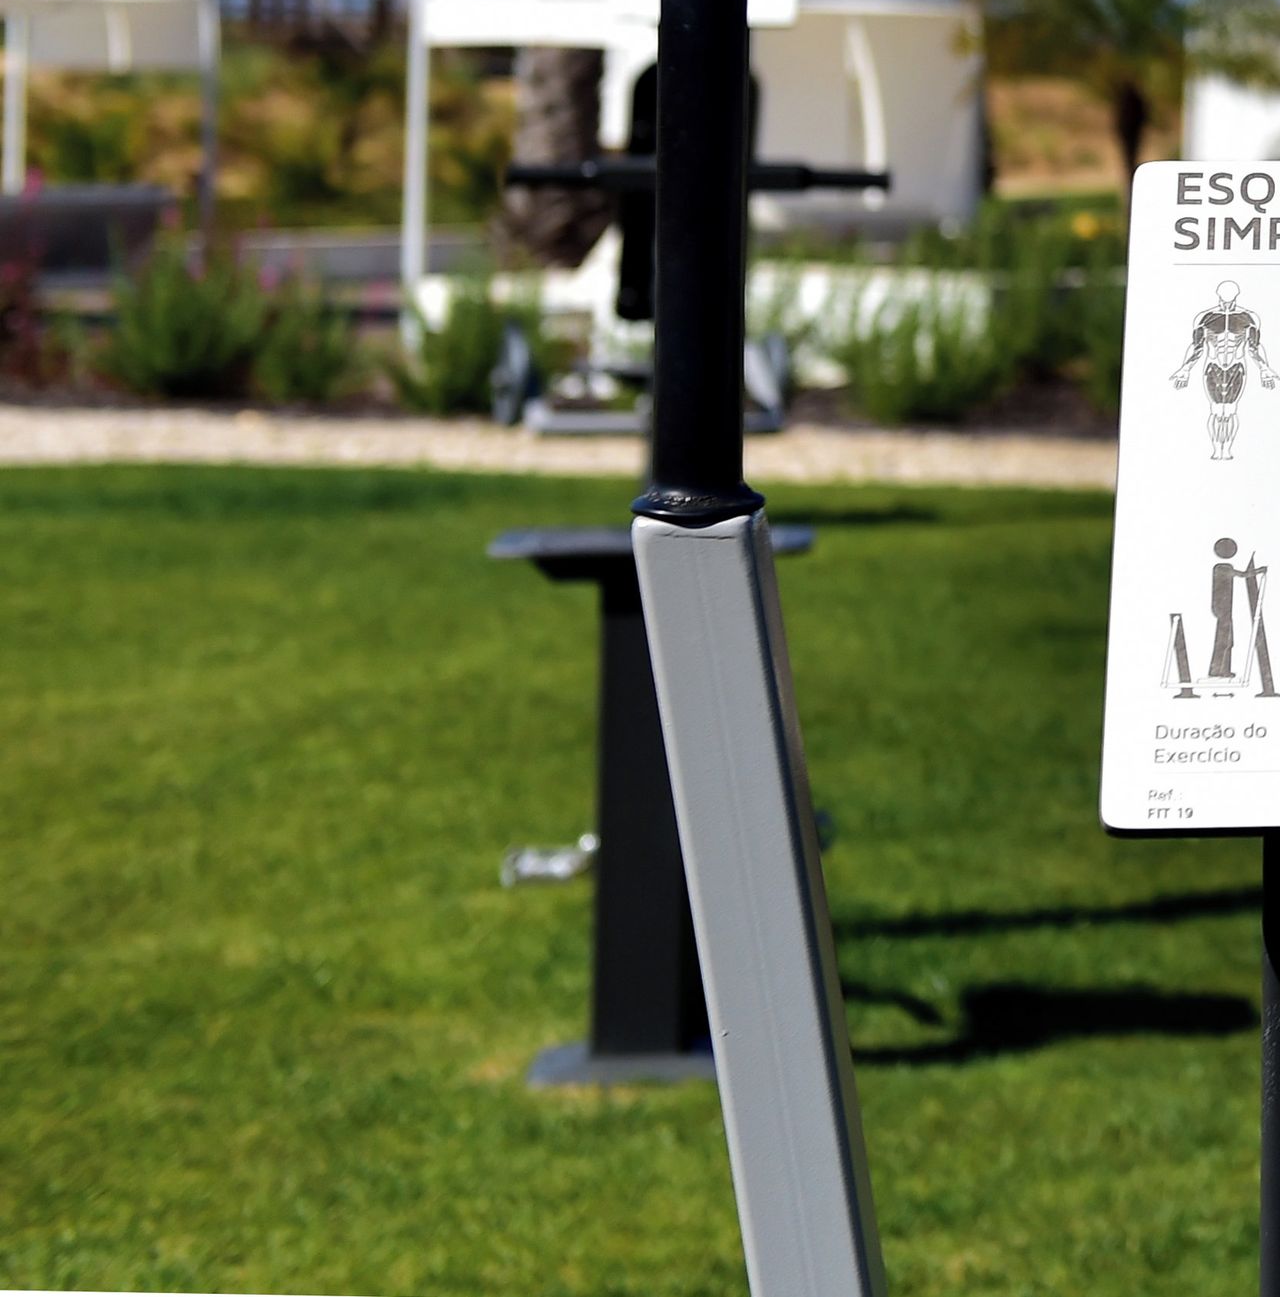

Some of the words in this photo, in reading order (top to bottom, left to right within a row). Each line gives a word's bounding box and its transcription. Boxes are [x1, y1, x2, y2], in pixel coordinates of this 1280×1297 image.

[1154, 723, 1236, 741] Duração
[1243, 722, 1268, 739] do
[1153, 747, 1242, 764] Exercício
[1147, 807, 1171, 820] FIT
[1178, 807, 1194, 820] 19
